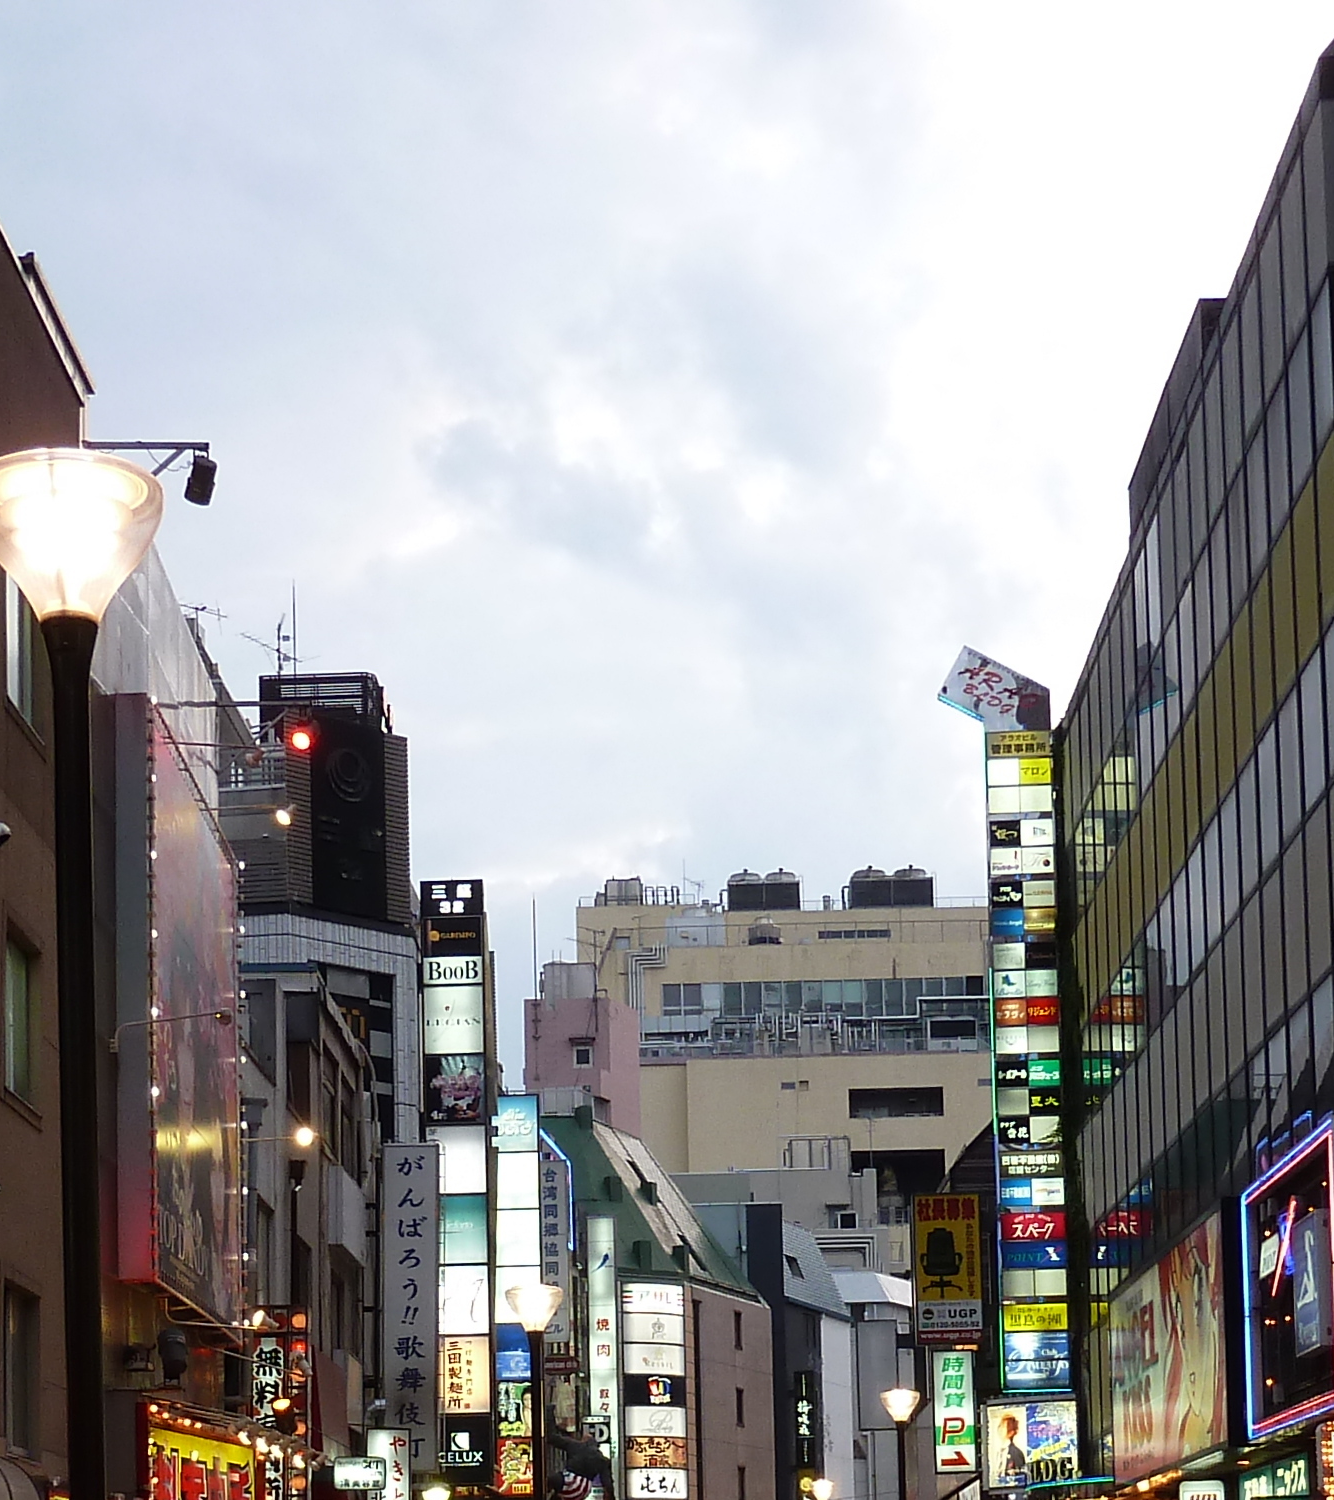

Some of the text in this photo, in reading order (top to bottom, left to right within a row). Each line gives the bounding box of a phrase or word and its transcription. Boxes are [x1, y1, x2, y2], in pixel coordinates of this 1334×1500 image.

[1011, 1223, 1055, 1240] スパーク
[948, 1309, 978, 1319] UGP
[596, 1318, 611, 1357] 焼肉
[940, 1417, 966, 1446] P
